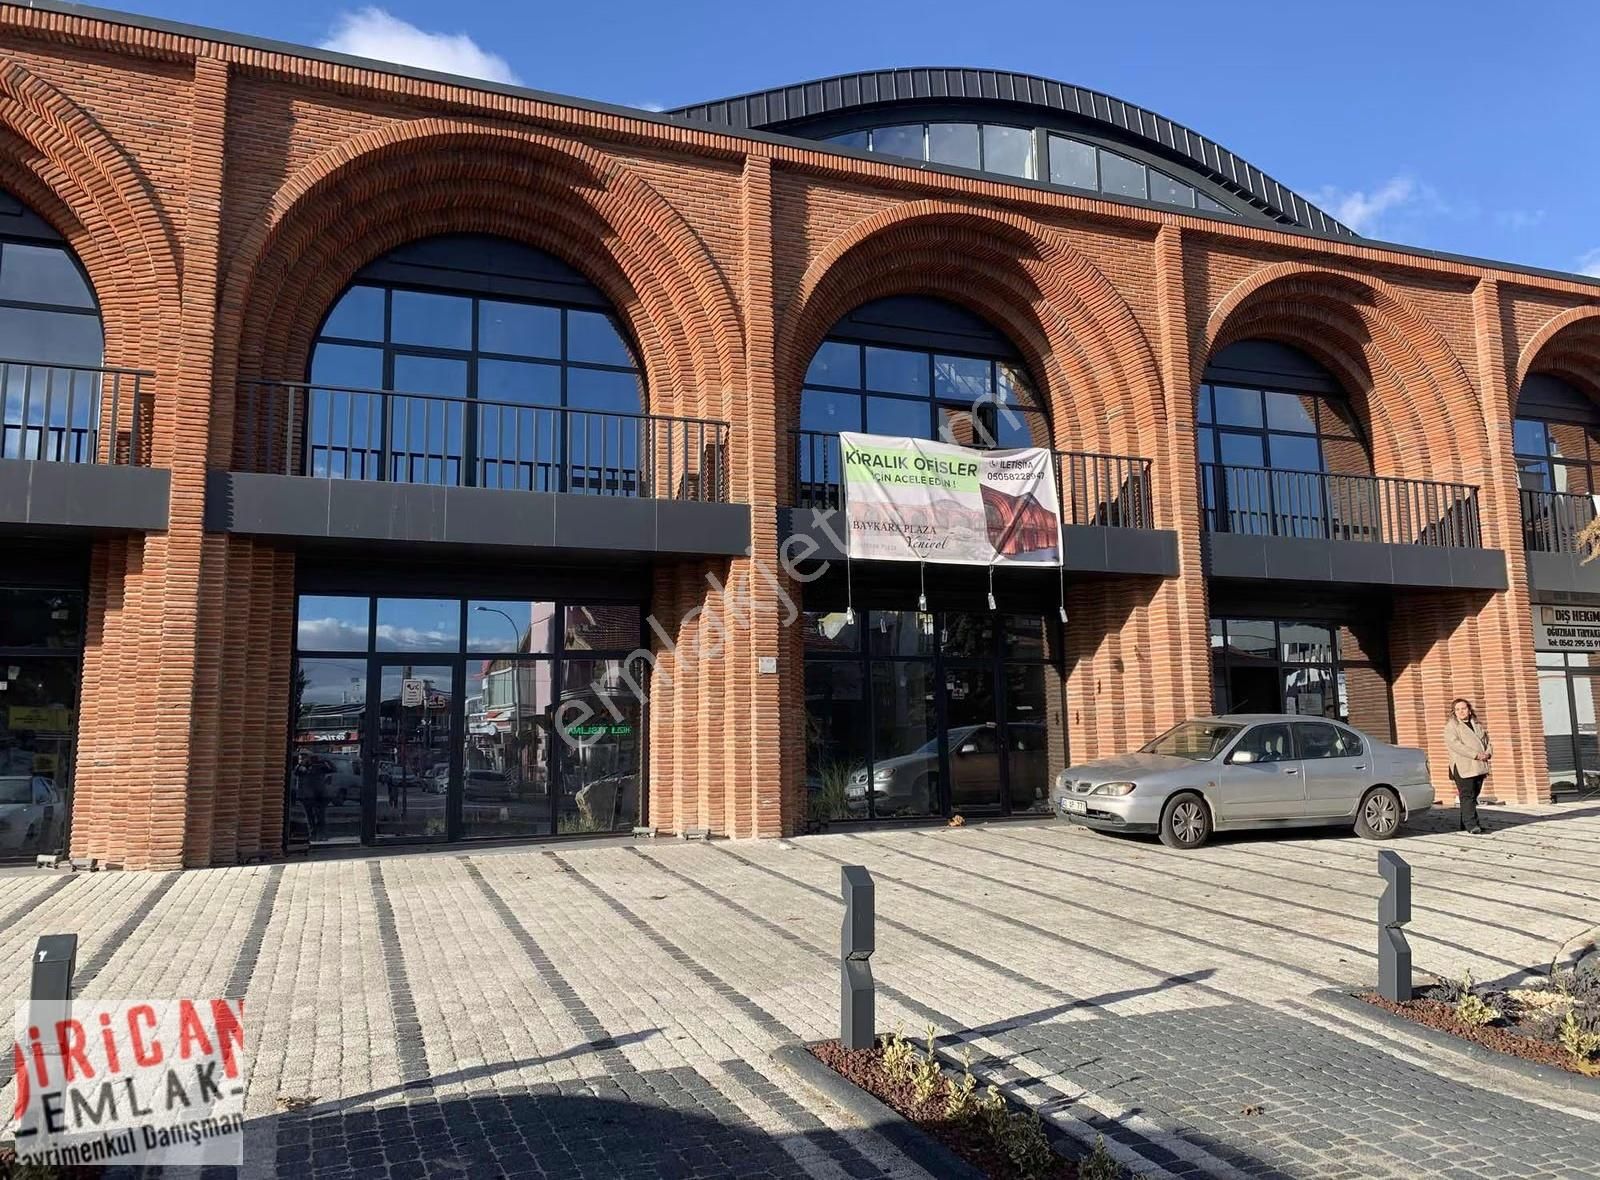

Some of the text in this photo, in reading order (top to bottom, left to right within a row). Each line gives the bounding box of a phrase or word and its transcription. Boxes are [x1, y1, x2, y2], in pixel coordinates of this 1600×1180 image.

[845, 449, 979, 477] KİRALIK OFİSLER
[894, 474, 927, 485] ACELE
[904, 524, 937, 535] PLAZA
